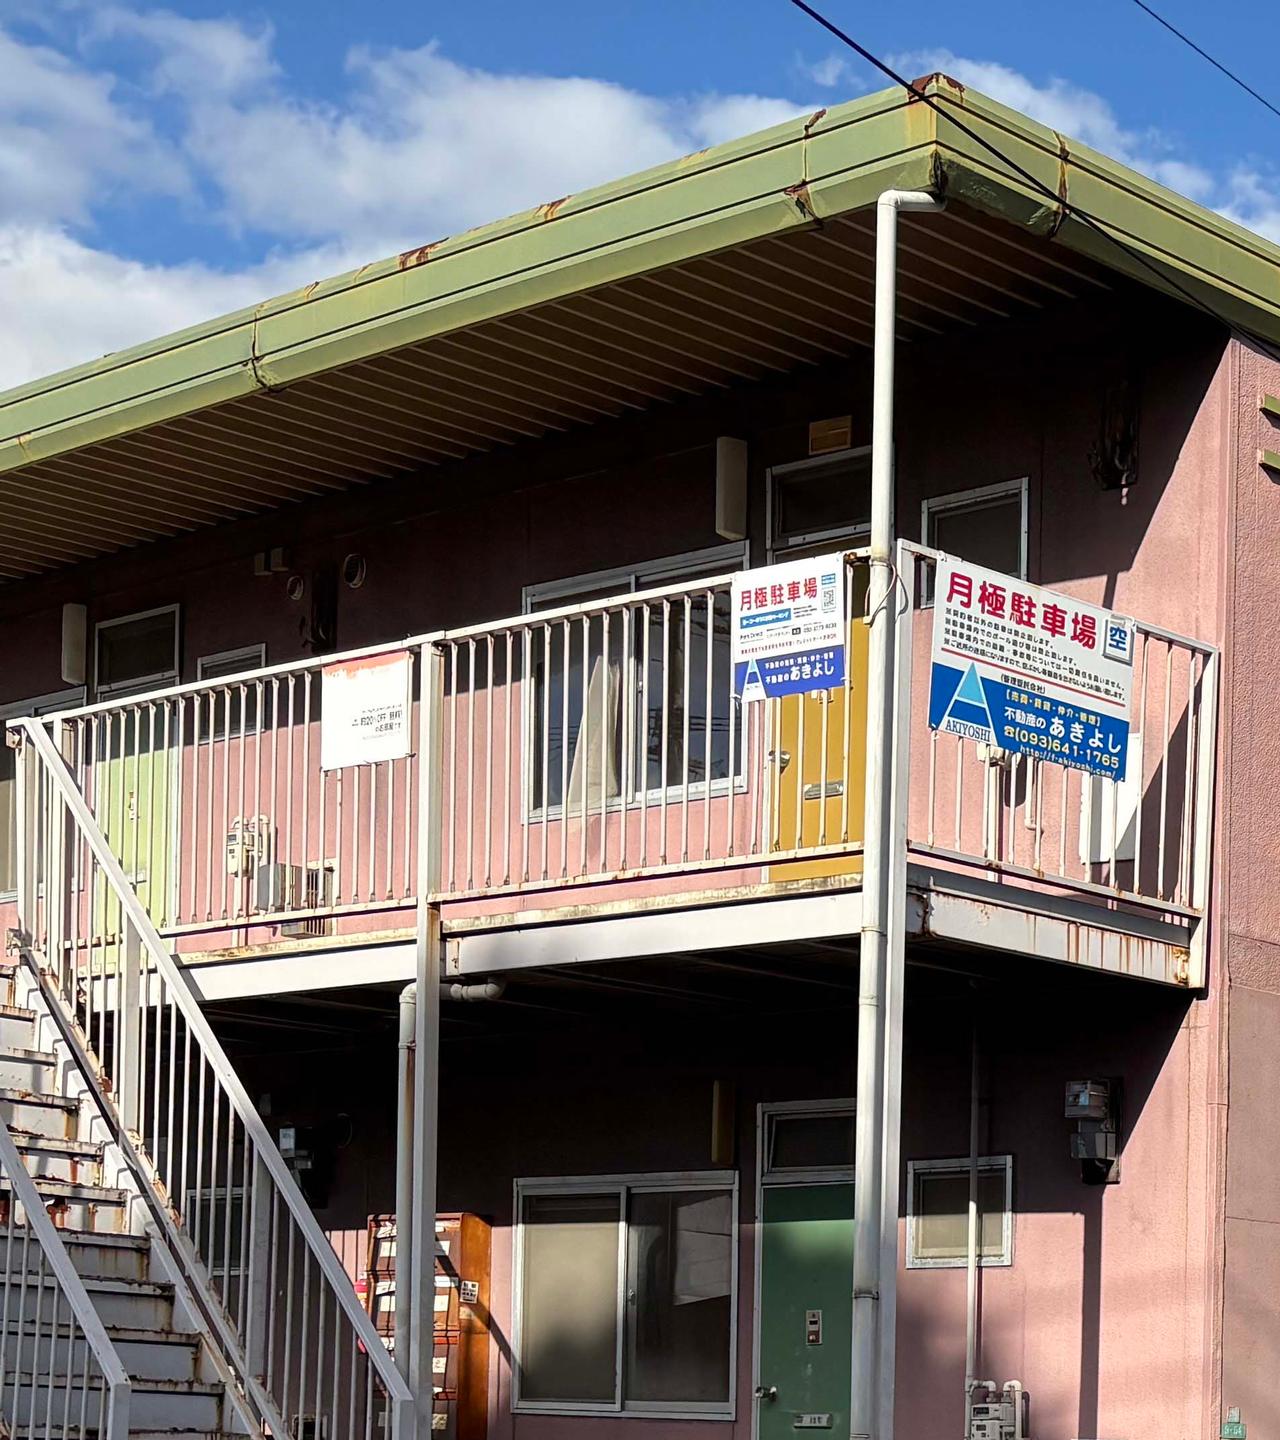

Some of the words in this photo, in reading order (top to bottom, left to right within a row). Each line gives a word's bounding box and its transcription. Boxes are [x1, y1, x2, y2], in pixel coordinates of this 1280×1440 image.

[740, 577, 818, 611] 月極駐車場
[947, 572, 1097, 650] 月極駐車場
[1108, 626, 1128, 652] 空
[945, 718, 991, 743] AKIYOSHI
